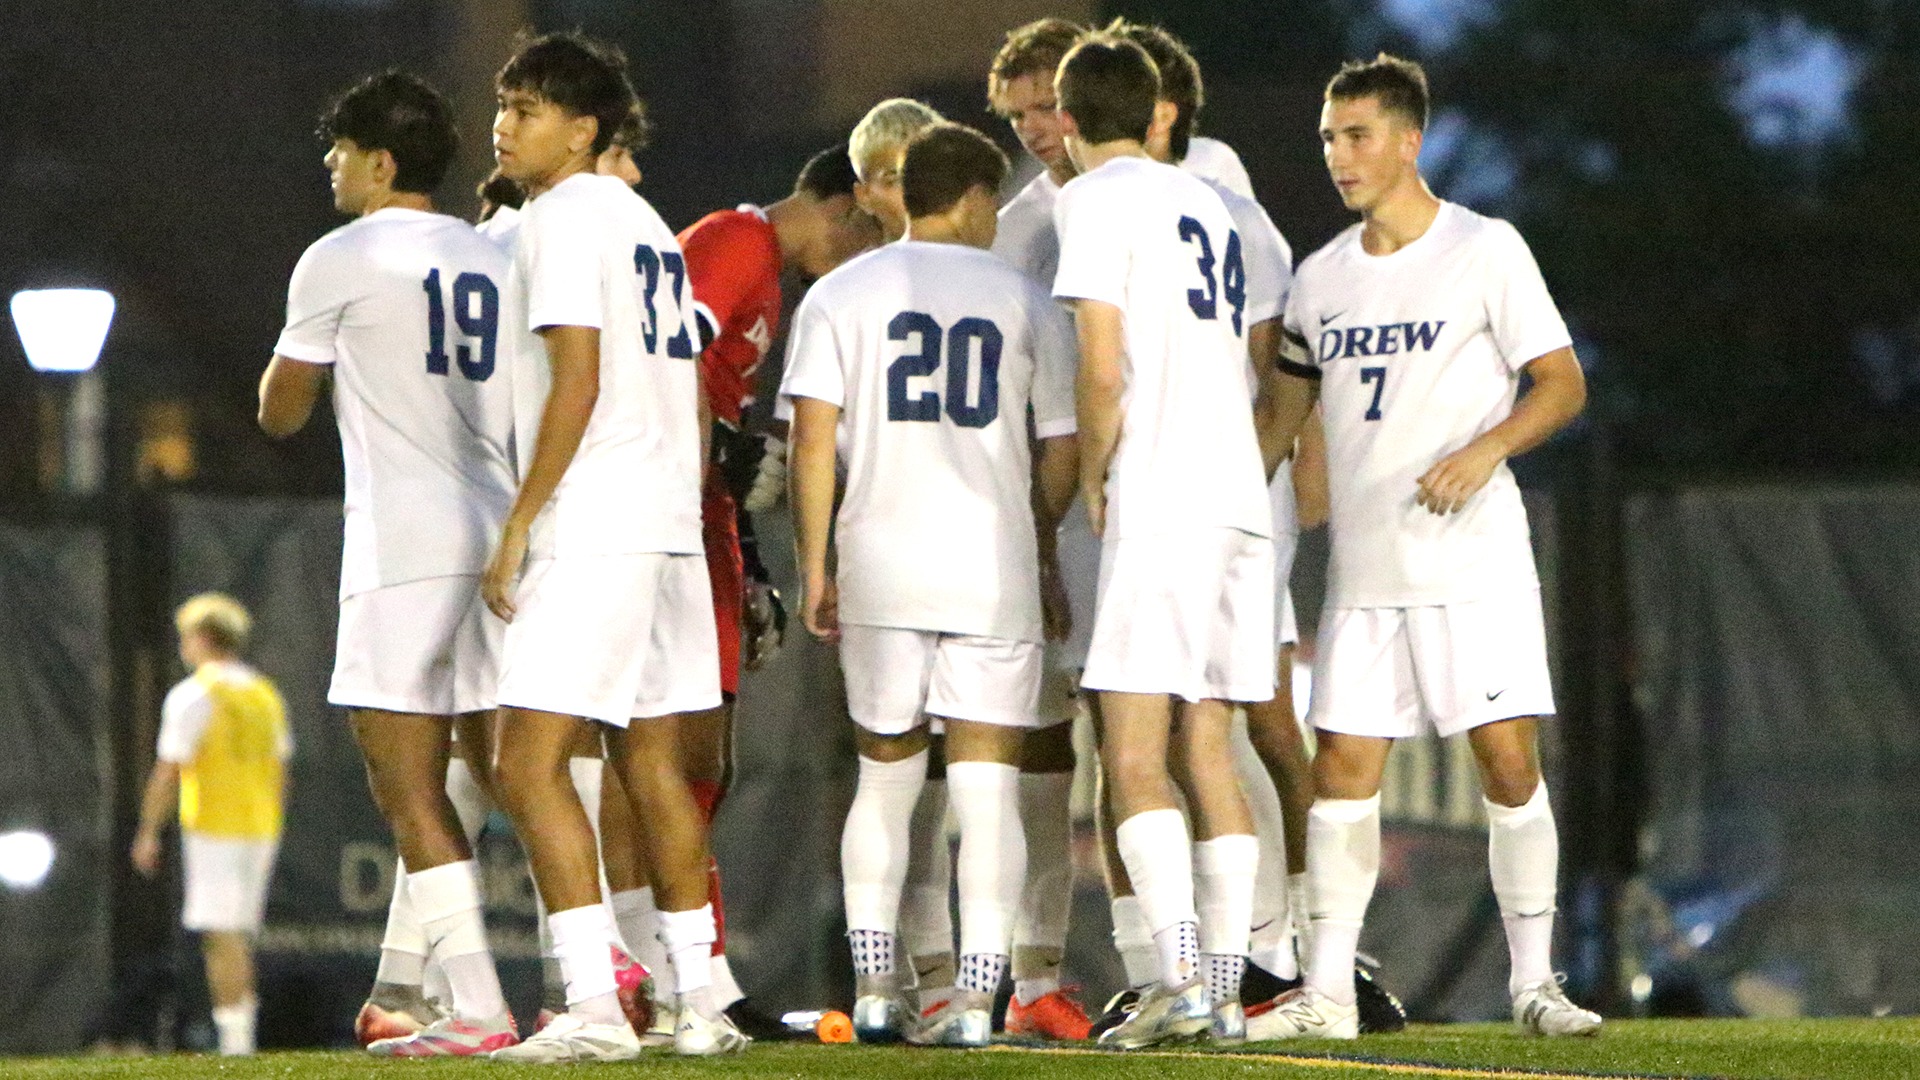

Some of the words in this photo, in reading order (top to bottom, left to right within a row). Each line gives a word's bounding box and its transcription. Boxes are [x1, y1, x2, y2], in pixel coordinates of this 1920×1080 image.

[422, 267, 499, 382] 19
[633, 243, 692, 359] 37
[1177, 215, 1246, 338] 34
[887, 311, 1003, 428] 20
[1319, 321, 1447, 363] DREW
[1360, 366, 1387, 421] 7
